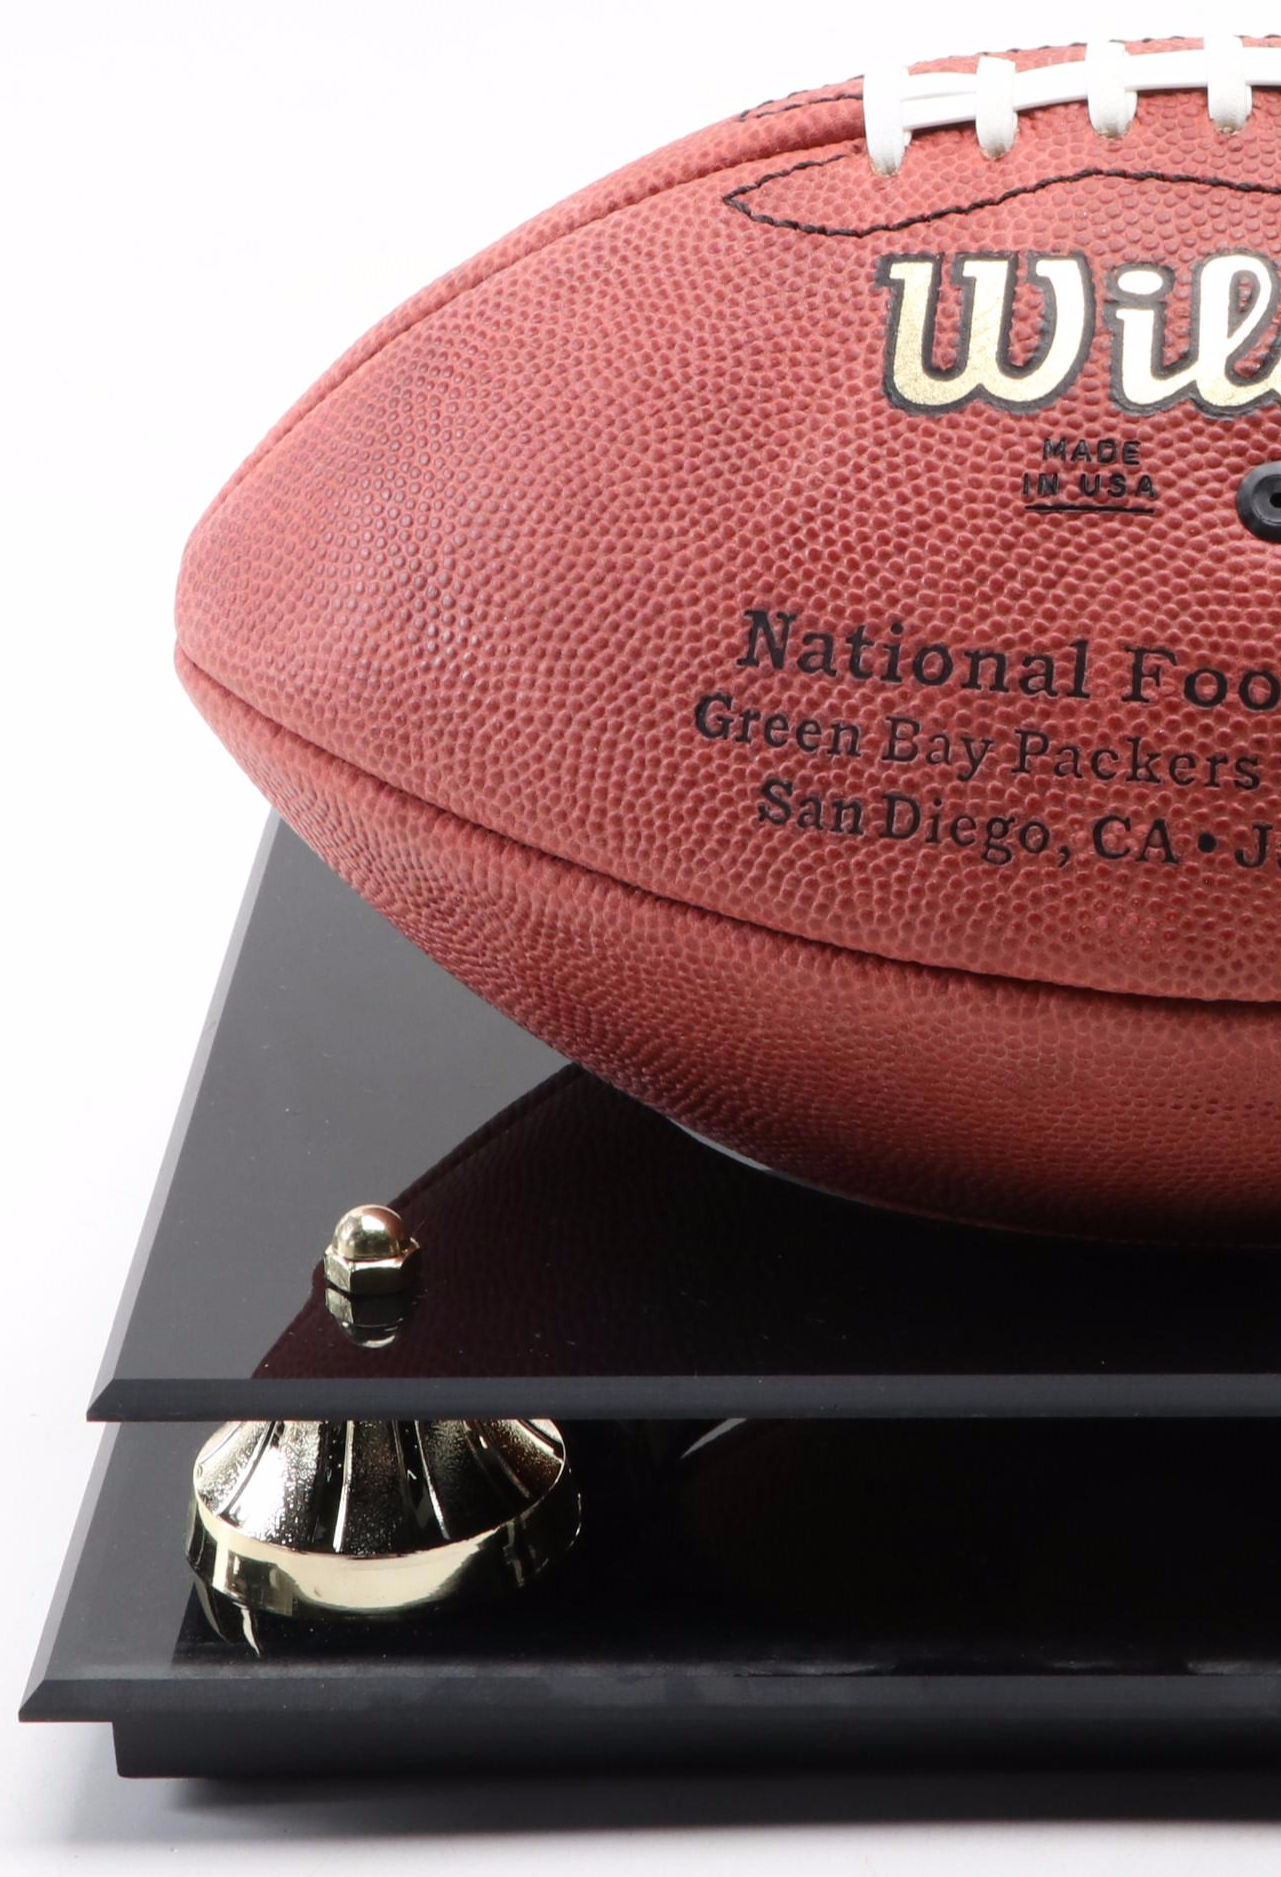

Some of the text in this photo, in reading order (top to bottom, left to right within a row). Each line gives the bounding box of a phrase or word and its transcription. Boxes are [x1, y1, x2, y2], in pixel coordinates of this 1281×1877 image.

[1023, 473, 1156, 499] IN USA
[1043, 437, 1141, 465] MADE
[737, 608, 1091, 700] National
[693, 692, 862, 757] Green
[881, 717, 994, 782] Bay
[1011, 729, 1261, 791] Packers
[757, 777, 864, 836] San
[880, 793, 1072, 868] Diego,
[1092, 814, 1180, 864] CA
